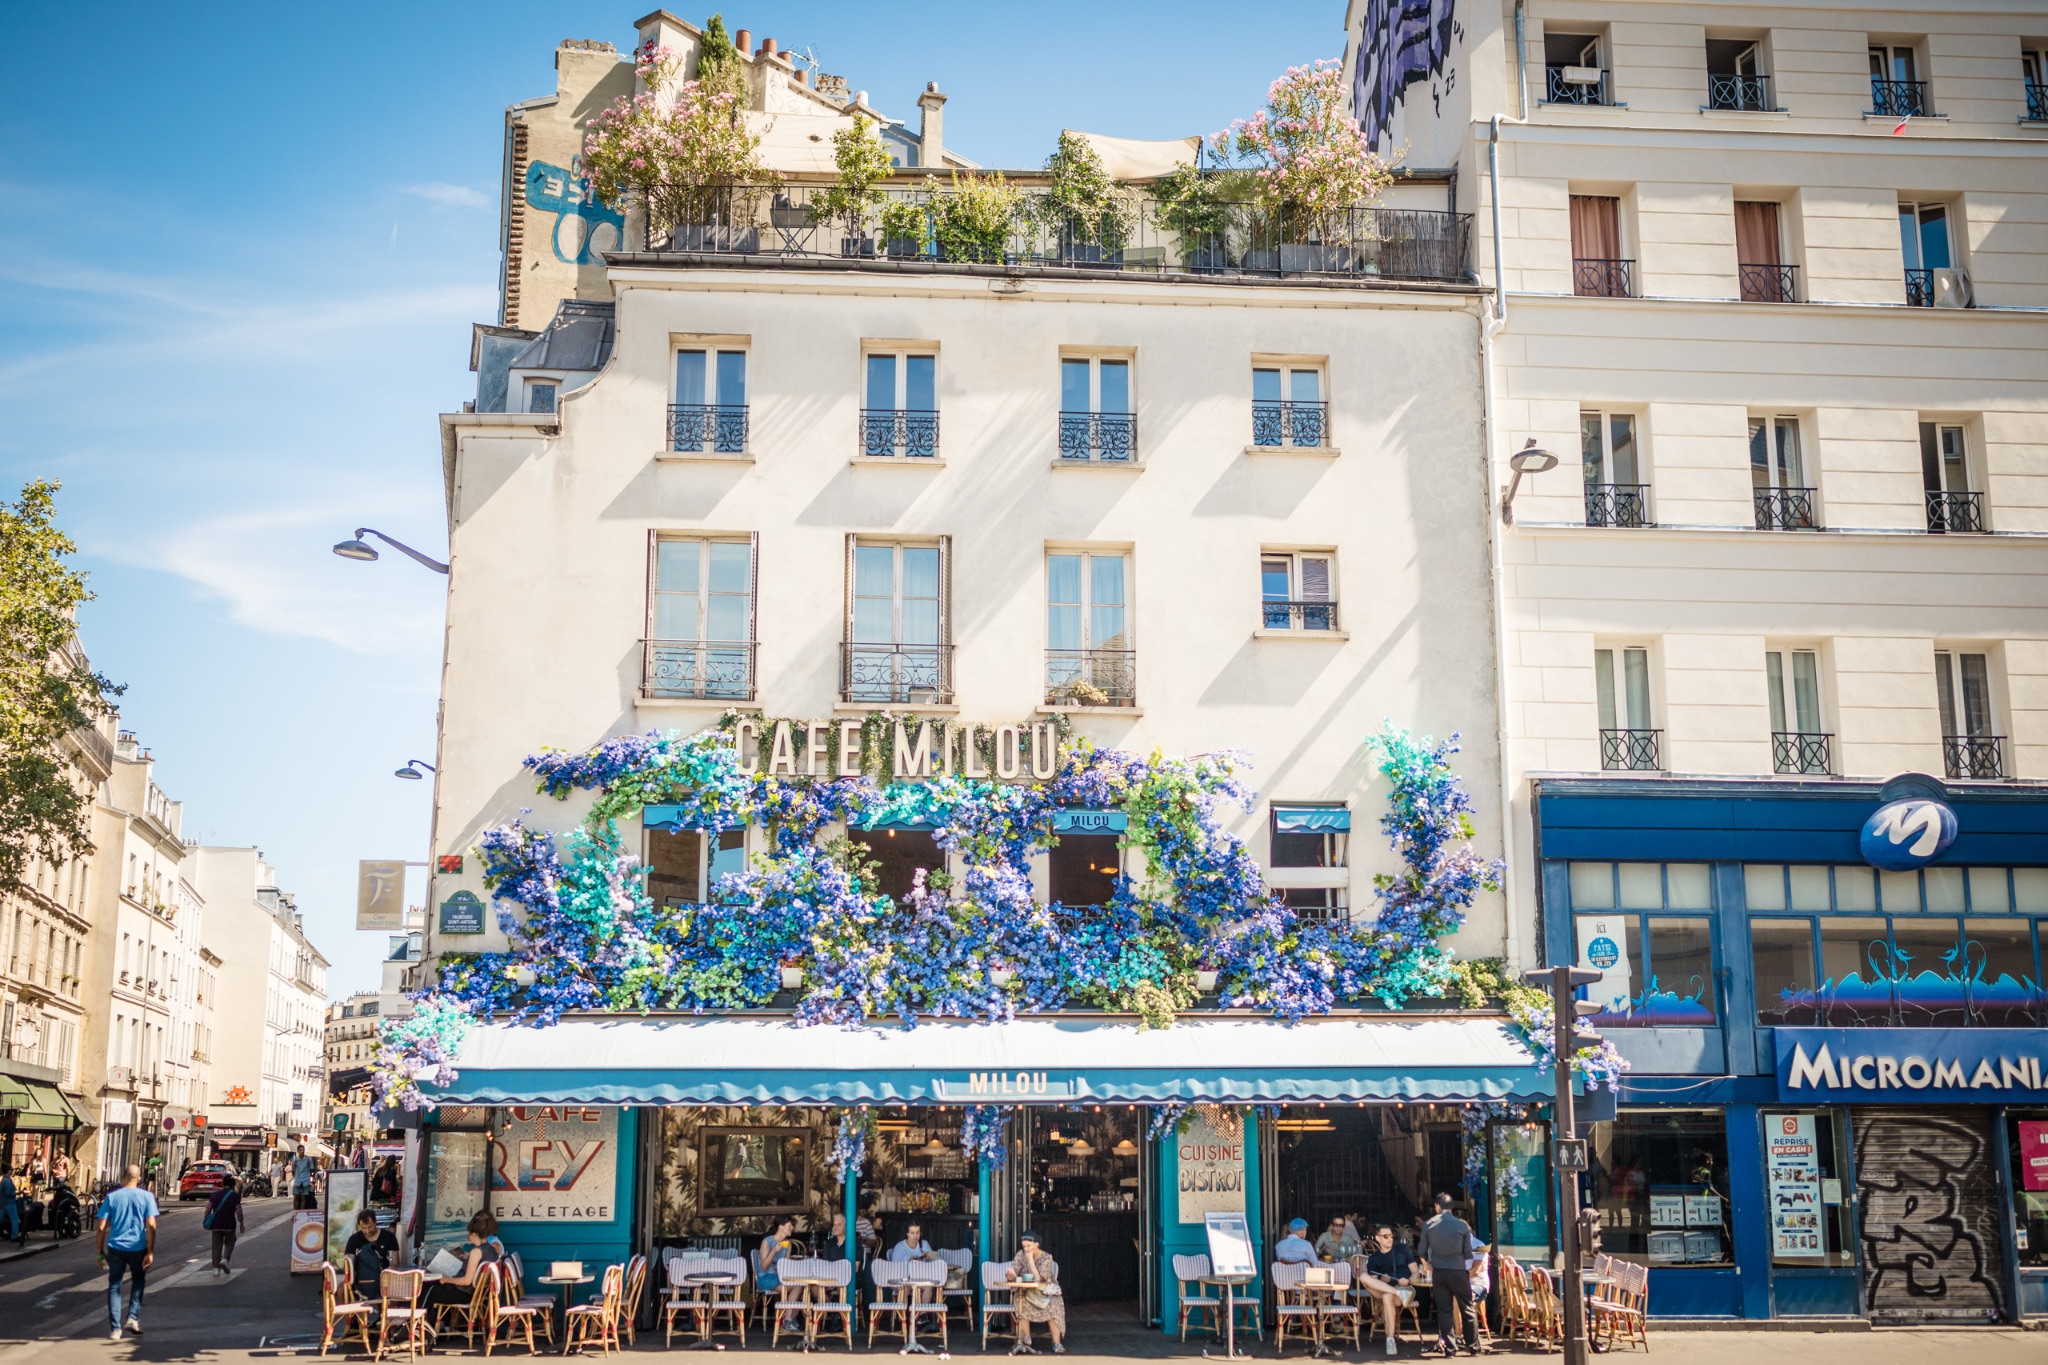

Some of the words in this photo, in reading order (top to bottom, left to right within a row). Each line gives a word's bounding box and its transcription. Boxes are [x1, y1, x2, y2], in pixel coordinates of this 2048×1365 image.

[894, 721, 1056, 780] MILOU
[1071, 815, 1109, 826] MILOU
[1788, 1041, 2048, 1090] MICROMANI
[969, 1072, 1047, 1094] MILOU
[1180, 1145, 1242, 1161] CUISINE
[467, 1140, 605, 1191] REY
[1180, 1169, 1243, 1192] BISTROT
[444, 1206, 505, 1218] SALE
[512, 1203, 527, 1218] À
